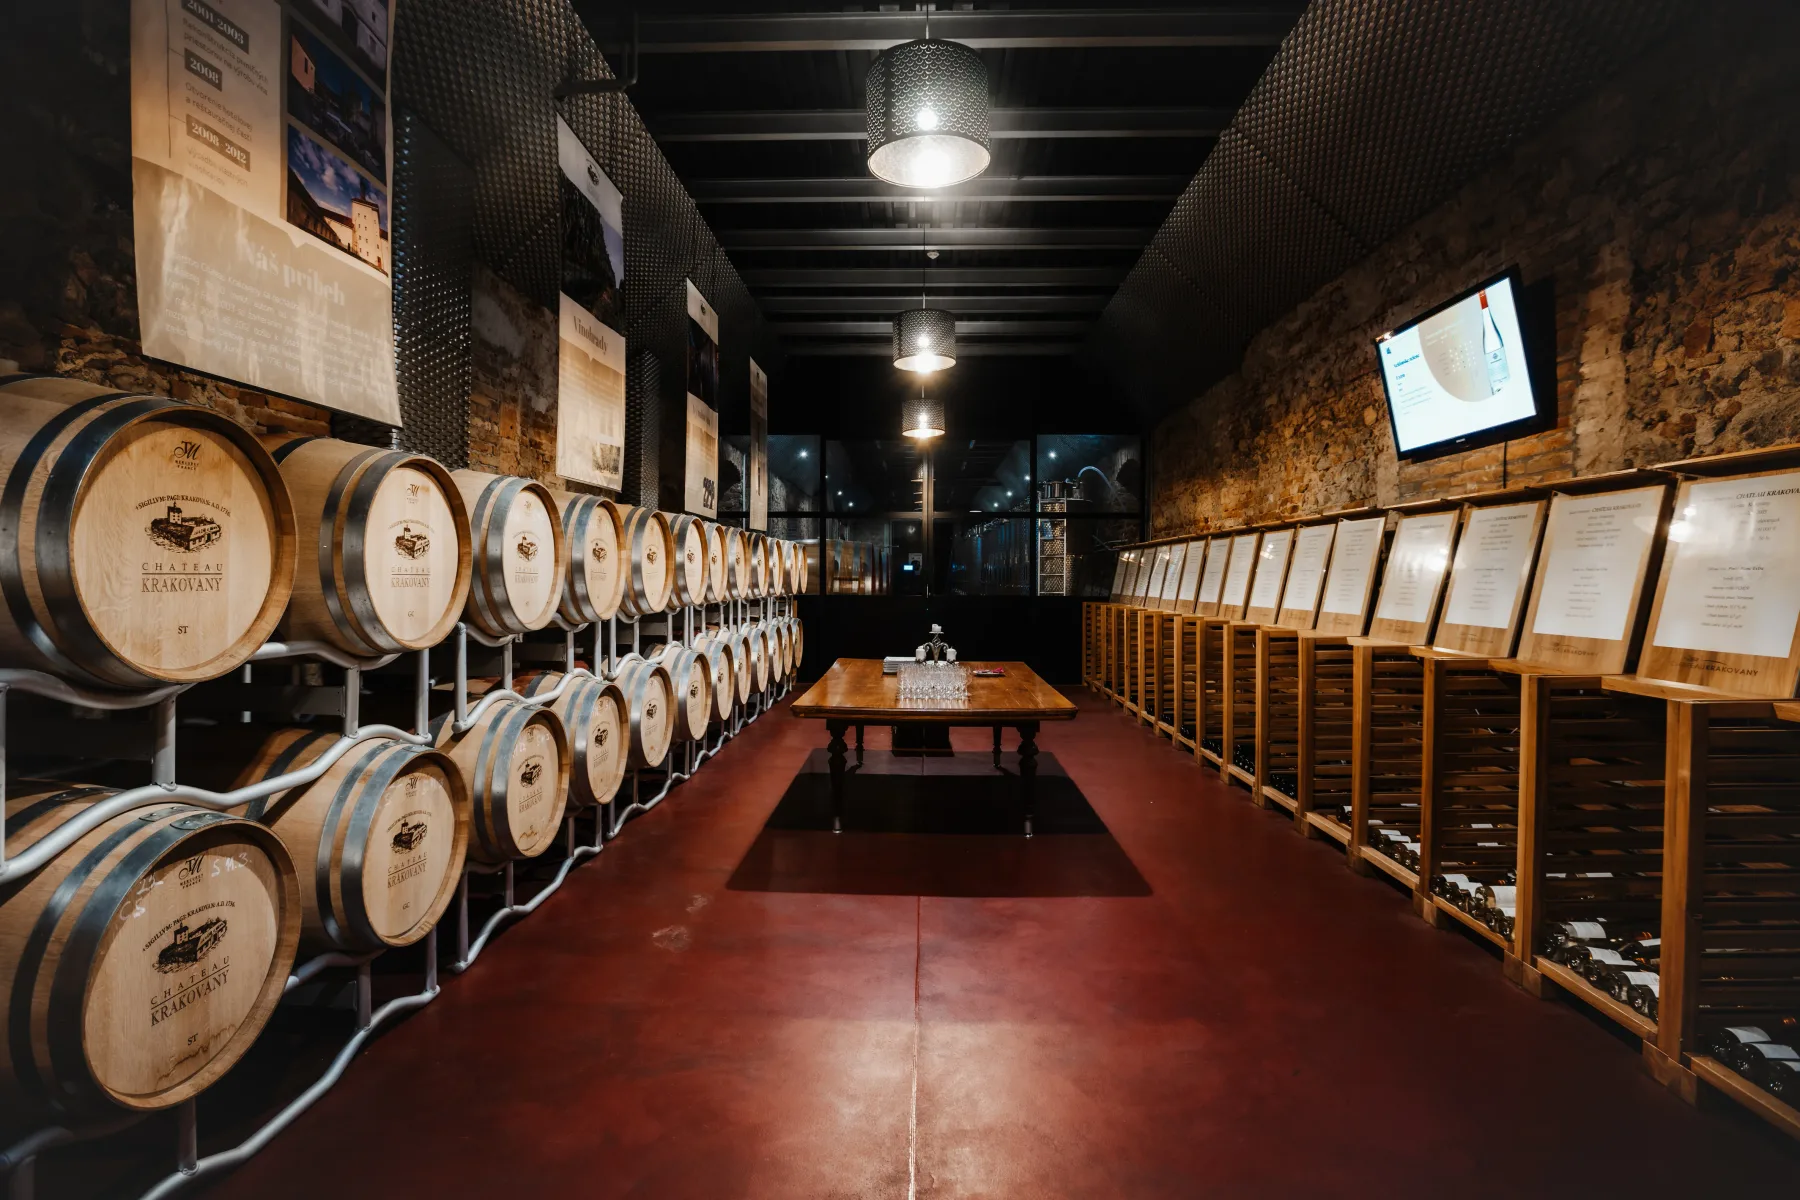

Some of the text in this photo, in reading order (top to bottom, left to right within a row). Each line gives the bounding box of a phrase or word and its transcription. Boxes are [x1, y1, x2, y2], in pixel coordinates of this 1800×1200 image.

[190, 57, 219, 84] 2008
[185, 82, 253, 133] Otvorenie hotelovej
[191, 122, 220, 147] 2008
[225, 142, 247, 164] 2012
[237, 233, 279, 276] Náš
[283, 263, 345, 306] príbeh
[573, 315, 609, 356] Vinohrady
[142, 562, 223, 572] CHATEAU
[141, 577, 223, 593] KRAKOVANY
[390, 577, 431, 588] KRAKOVANY
[177, 625, 189, 635] ST
[387, 861, 427, 889] KRAKOVANY
[150, 955, 229, 1005] CHATEAU
[151, 969, 229, 1027] KRAKOVANY
[187, 1032, 199, 1046] ST
